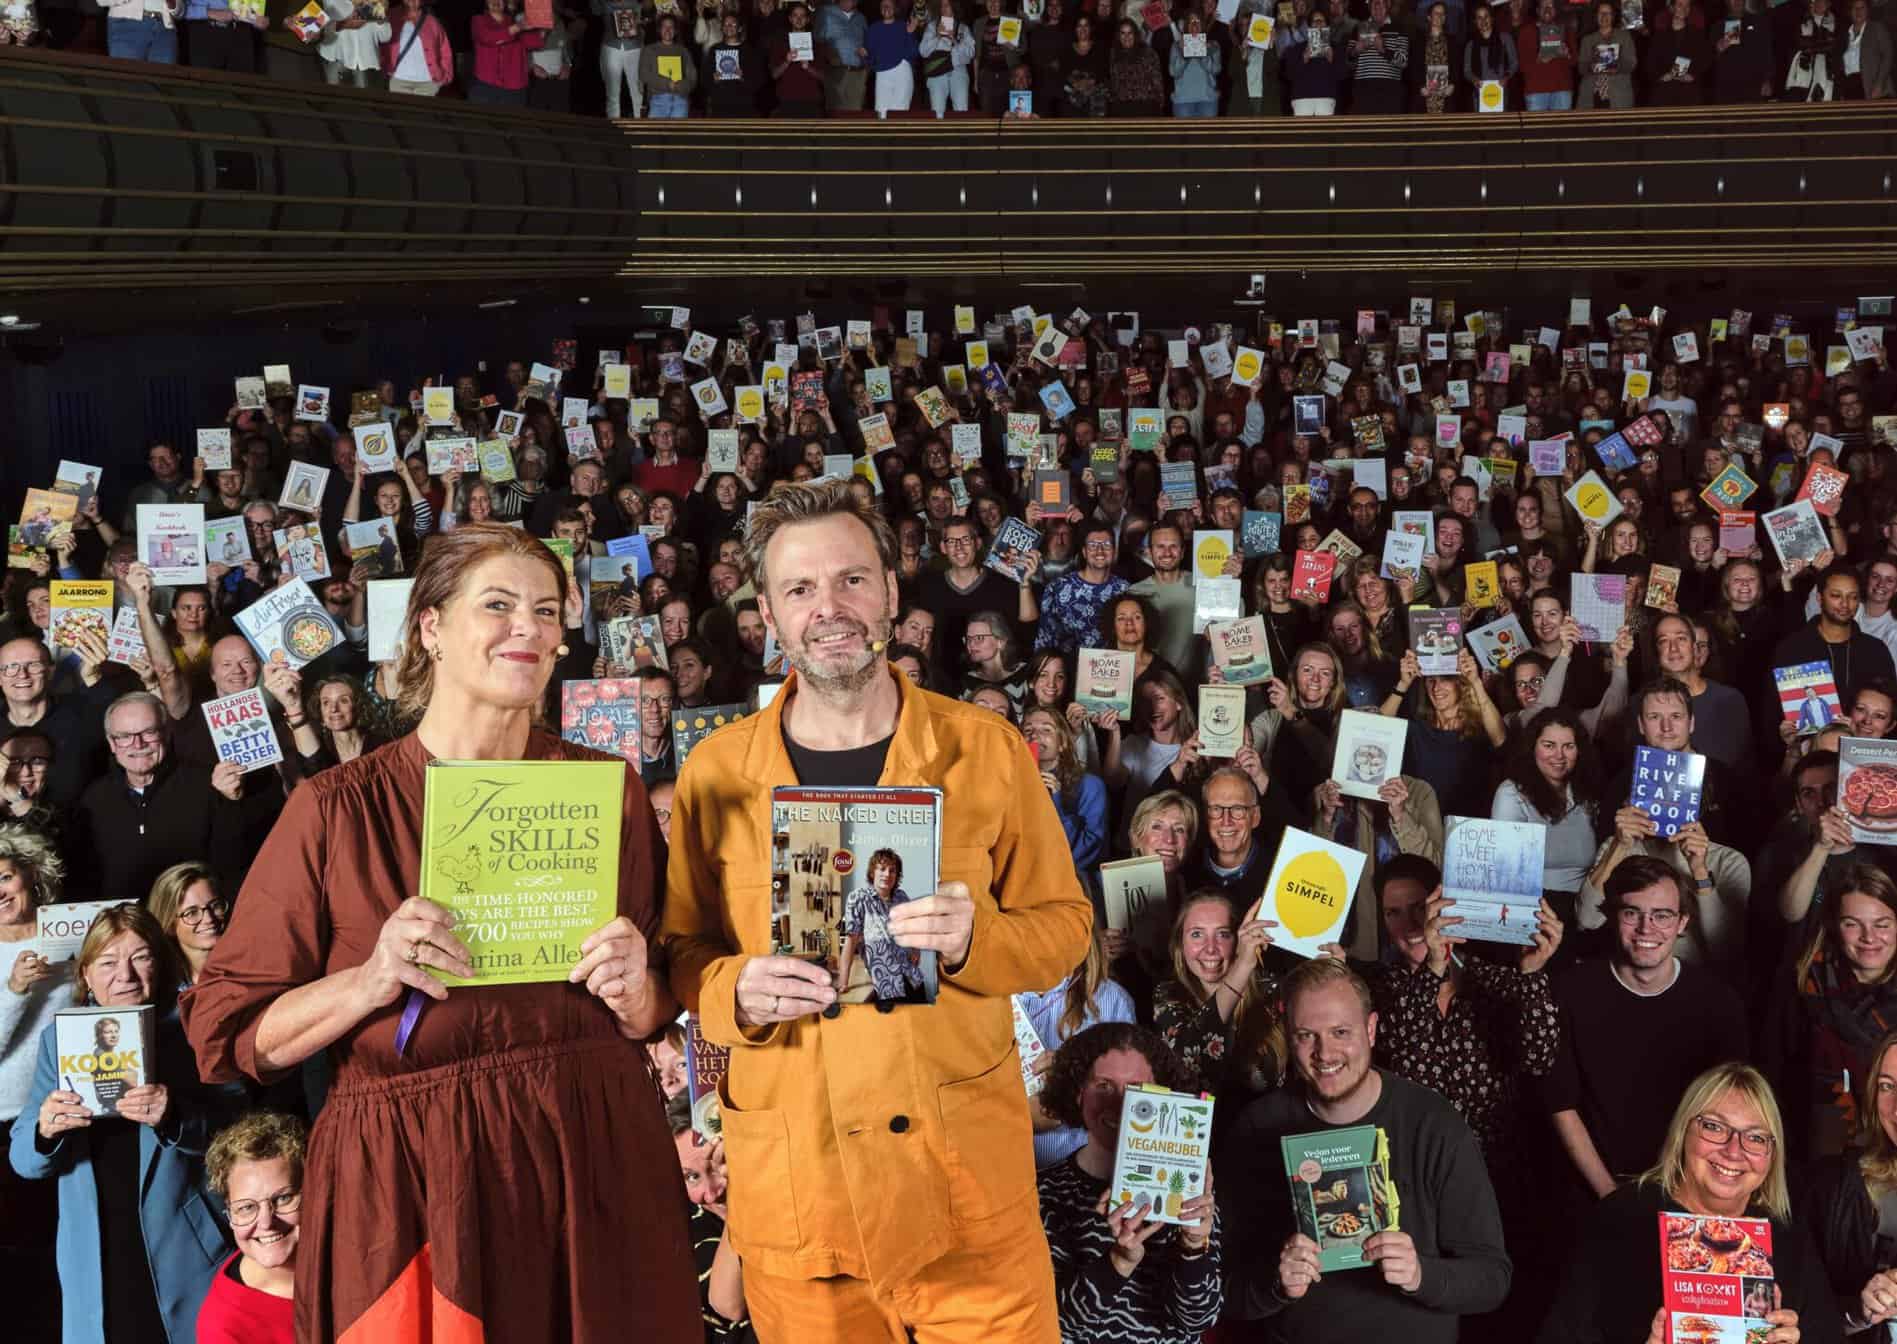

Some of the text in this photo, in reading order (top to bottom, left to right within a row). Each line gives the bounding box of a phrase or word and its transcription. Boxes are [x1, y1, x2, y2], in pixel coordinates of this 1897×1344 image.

[58, 588, 107, 596] JAARROND
[207, 693, 259, 714] HOLLANDSE
[210, 701, 263, 730] KAAS
[220, 730, 270, 757] BETTY
[1637, 784, 1698, 804] CAFE
[776, 806, 934, 825] THE NAKED CHEF
[489, 827, 600, 852] SKILLS
[891, 832, 929, 847] Oliver
[1458, 828, 1496, 841] HOME
[488, 852, 598, 874] of Cooking
[473, 895, 513, 906] TIME
[517, 890, 598, 904] HONORED
[1286, 881, 1335, 907] SIMPEL
[453, 908, 478, 921] AYS
[482, 907, 513, 919] ARE
[519, 906, 552, 917] THE
[466, 921, 508, 943] 700
[511, 921, 558, 930] RECIPES
[560, 918, 594, 928] SHOW
[511, 930, 565, 940] YOU WHY
[470, 949, 523, 969] arina
[693, 1043, 727, 1055] VAN
[60, 1050, 140, 1073] KOOK
[695, 1056, 728, 1070] HET
[697, 1072, 725, 1085] KO
[1303, 1144, 1352, 1159] Vegan voor
[1320, 1153, 1361, 1164] iedereen
[1674, 1280, 1694, 1293] LISA
